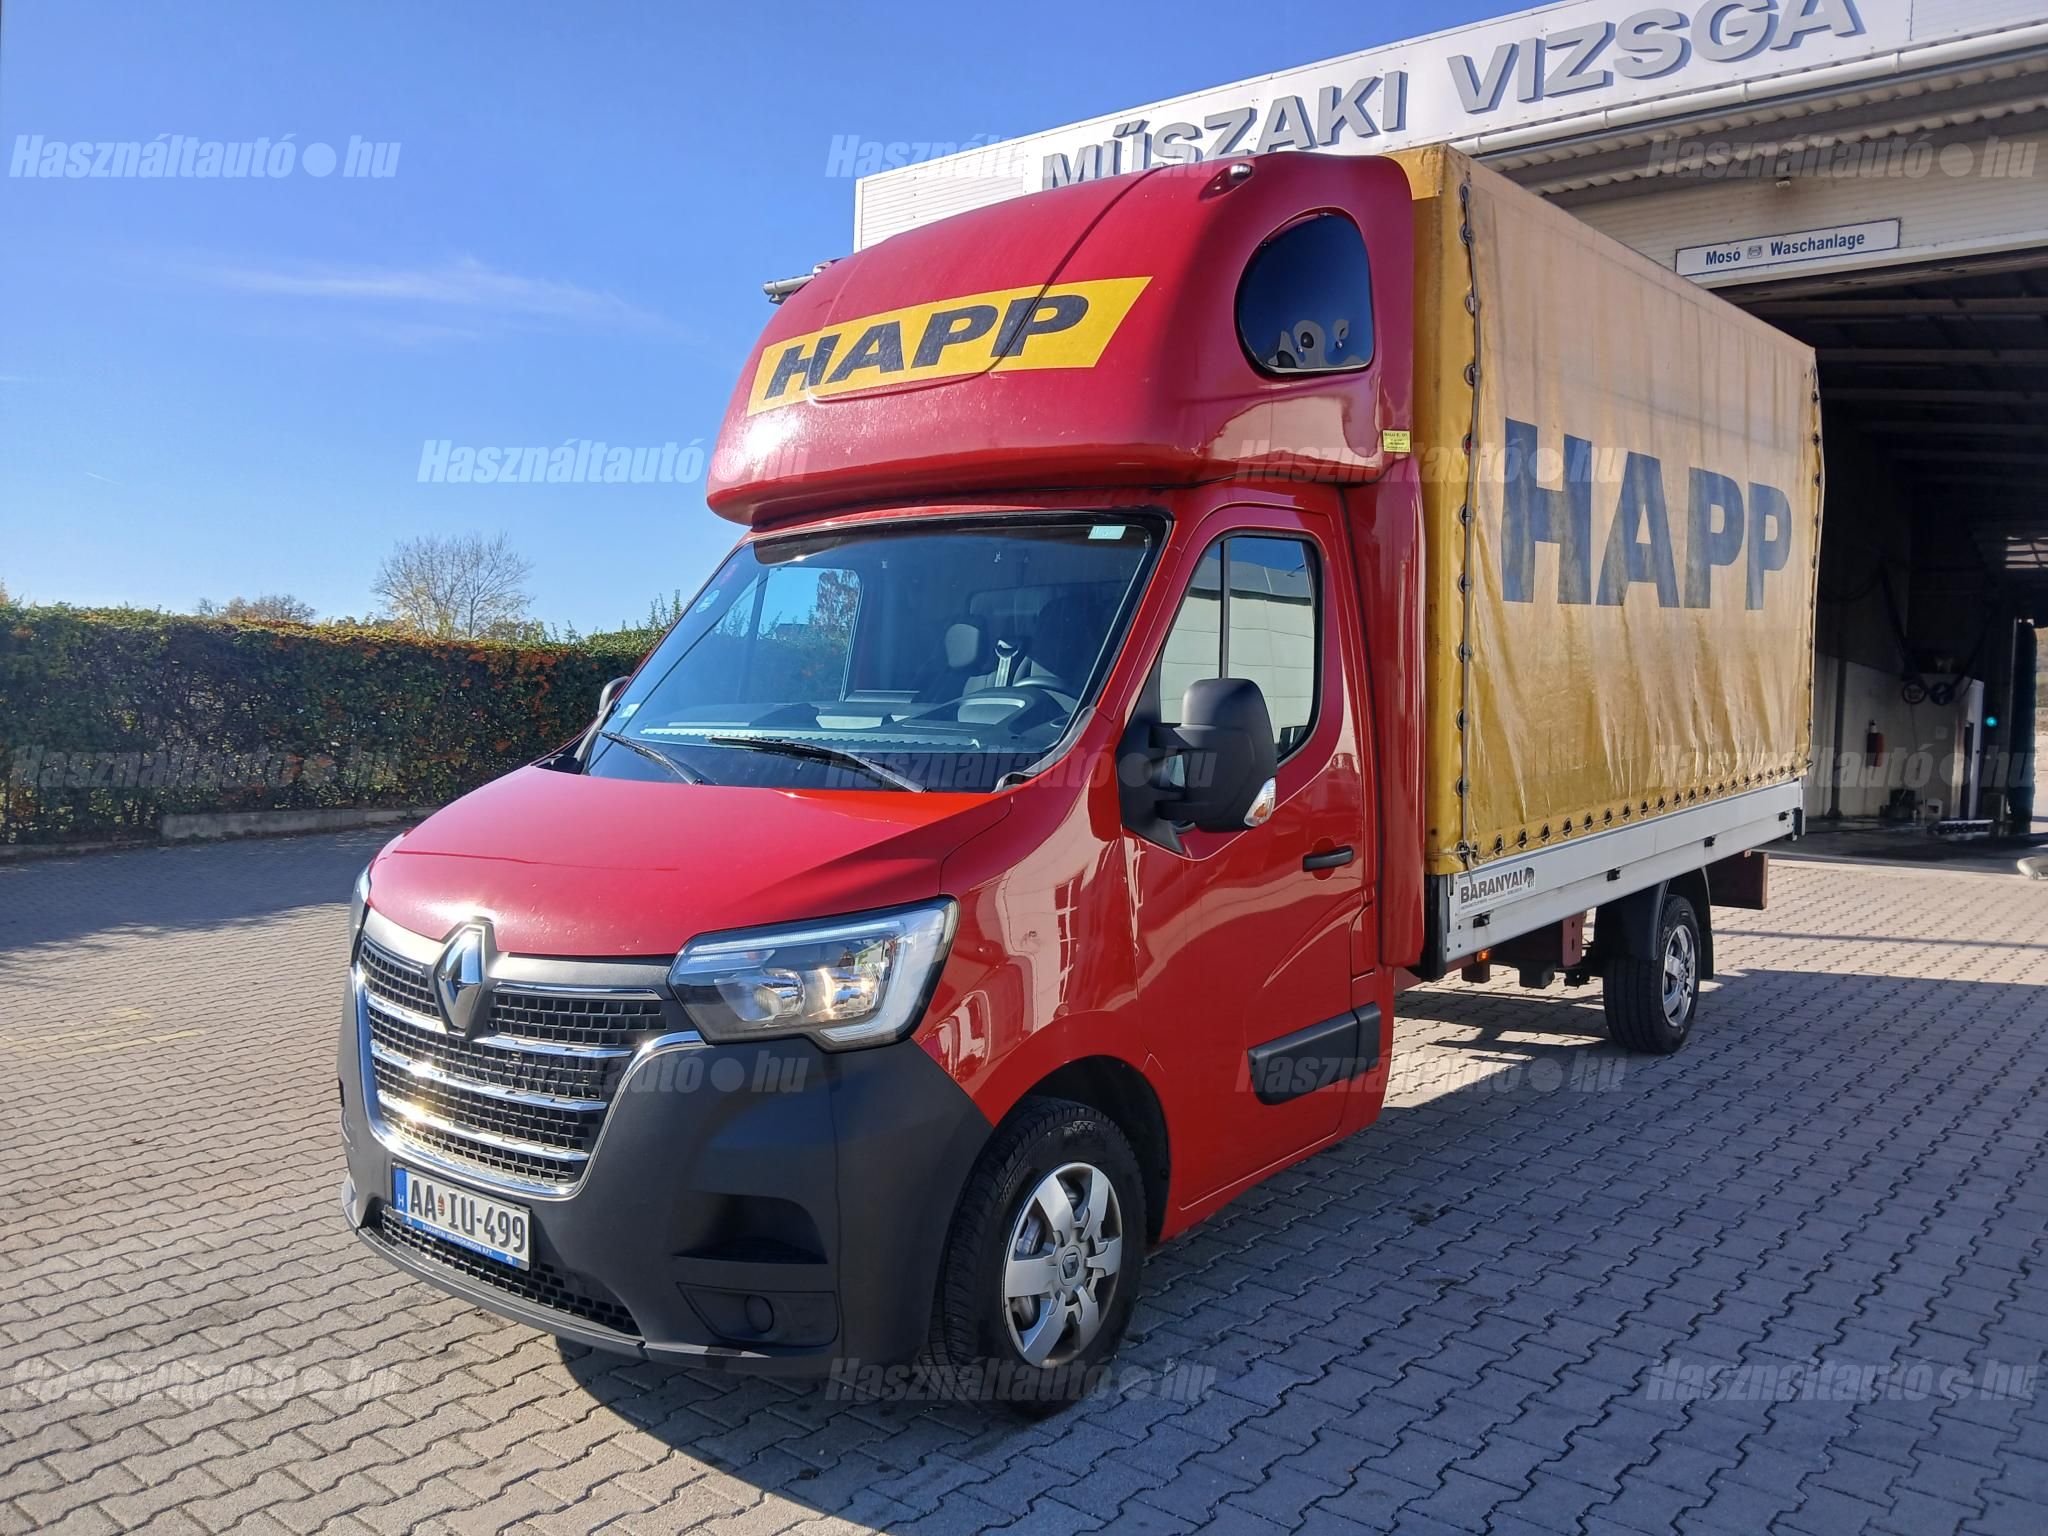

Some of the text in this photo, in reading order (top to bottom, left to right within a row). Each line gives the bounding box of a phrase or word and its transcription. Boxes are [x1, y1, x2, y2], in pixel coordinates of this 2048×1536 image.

[1042, 0, 1866, 190] MŰSZAKI VIZSGA
[1705, 231, 1865, 266] Mosó Waschanlage
[764, 294, 1090, 400] HAPP
[1500, 417, 1792, 610] HAPP
[1460, 869, 1523, 904] BARANYAI
